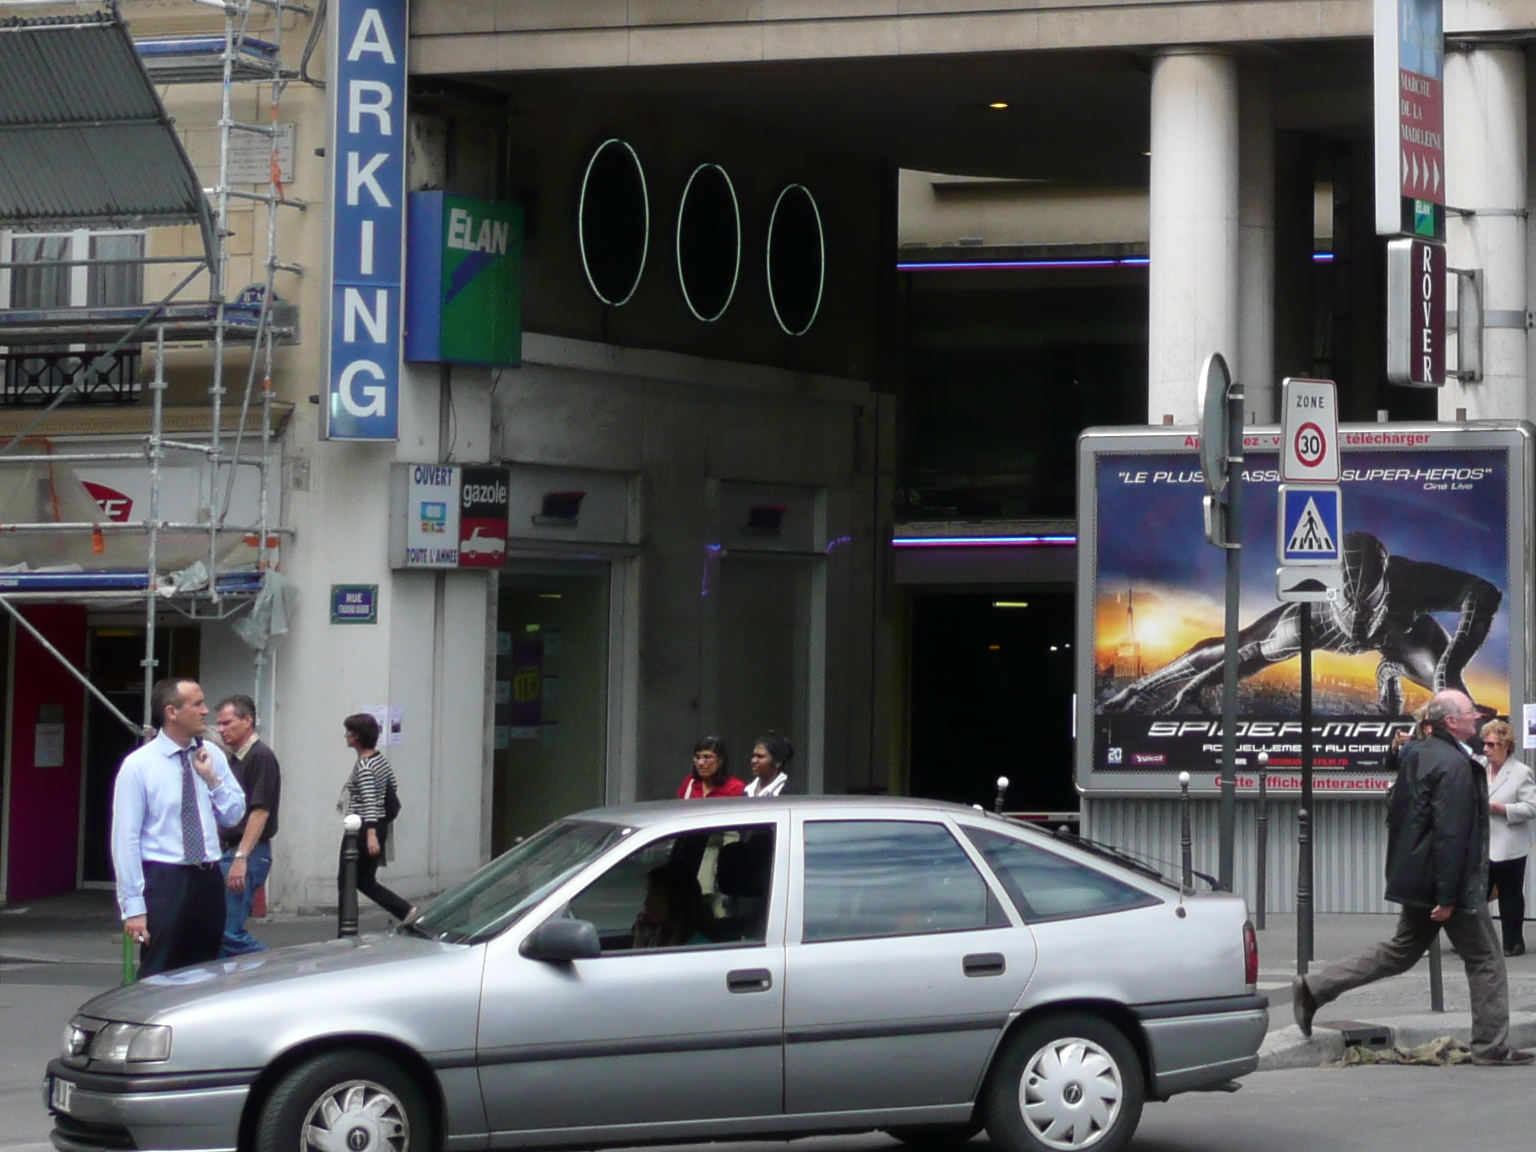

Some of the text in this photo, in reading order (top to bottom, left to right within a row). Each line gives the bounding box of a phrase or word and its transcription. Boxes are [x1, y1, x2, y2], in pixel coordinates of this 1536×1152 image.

[447, 207, 509, 255] ELAN
[1422, 245, 1433, 383] ROVER
[1296, 395, 1325, 409] ZONE
[1300, 435, 1320, 455] 30
[1346, 432, 1431, 449] télécharger
[414, 465, 453, 486] OUVERT
[463, 479, 507, 508] gazole
[346, 593, 364, 603] RUE
